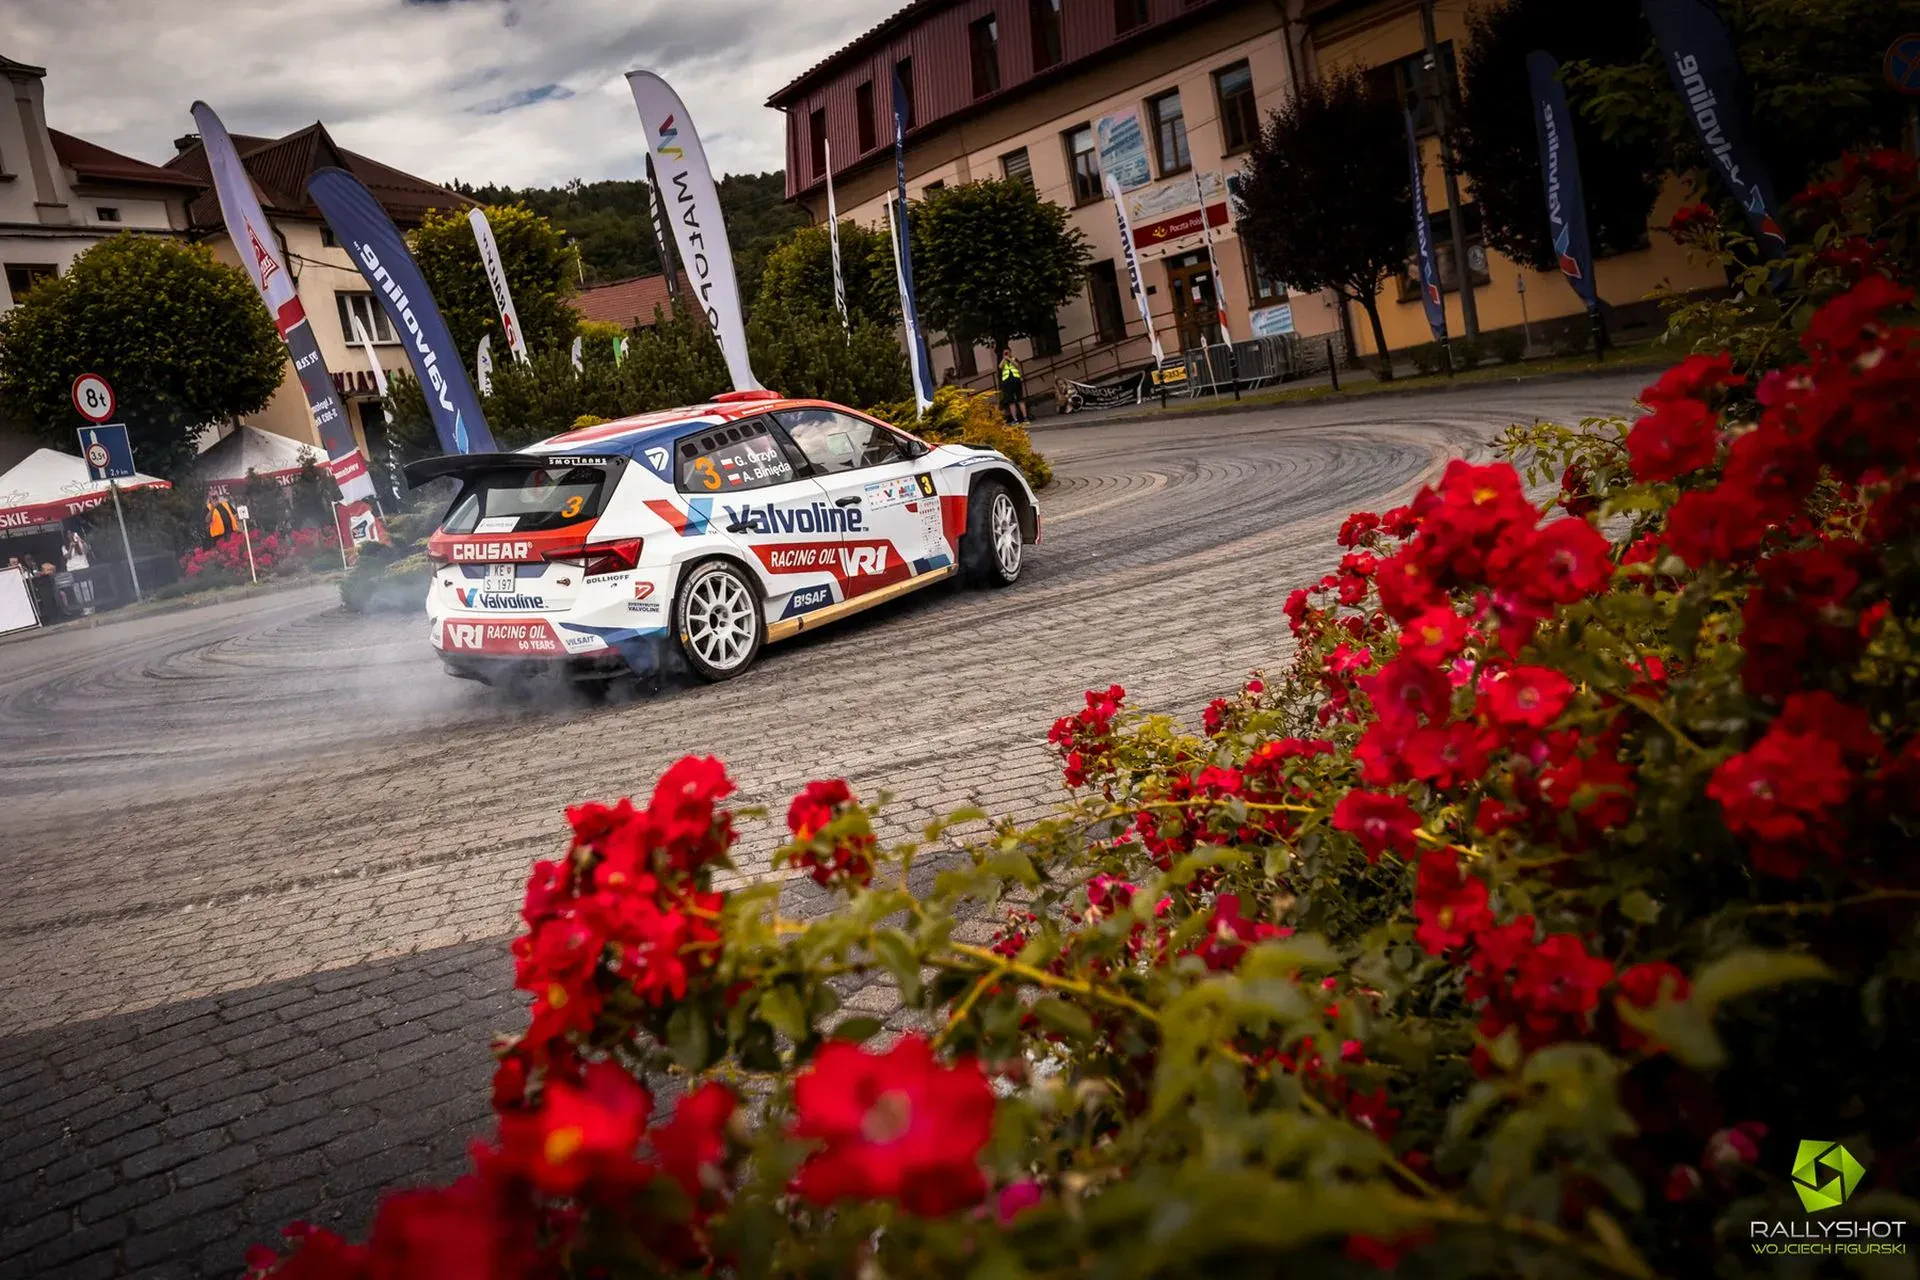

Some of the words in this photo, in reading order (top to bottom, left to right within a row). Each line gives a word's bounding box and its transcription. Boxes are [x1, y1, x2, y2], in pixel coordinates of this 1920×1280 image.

[1169, 222, 1188, 233] Poczta
[734, 455, 747, 467] G.
[695, 456, 722, 490] 3
[743, 470, 754, 483] A.
[921, 476, 932, 495] 3
[561, 495, 584, 518] 3
[722, 502, 863, 534] Valvoline
[453, 542, 528, 560] CRUSAR
[771, 548, 815, 568] RACING
[818, 547, 836, 565] OIL
[494, 565, 505, 577] KE
[479, 594, 545, 609] Valvoline
[486, 625, 526, 639] RACING
[529, 625, 547, 640] OIL
[518, 640, 529, 650] 60
[530, 639, 556, 651] YEARS
